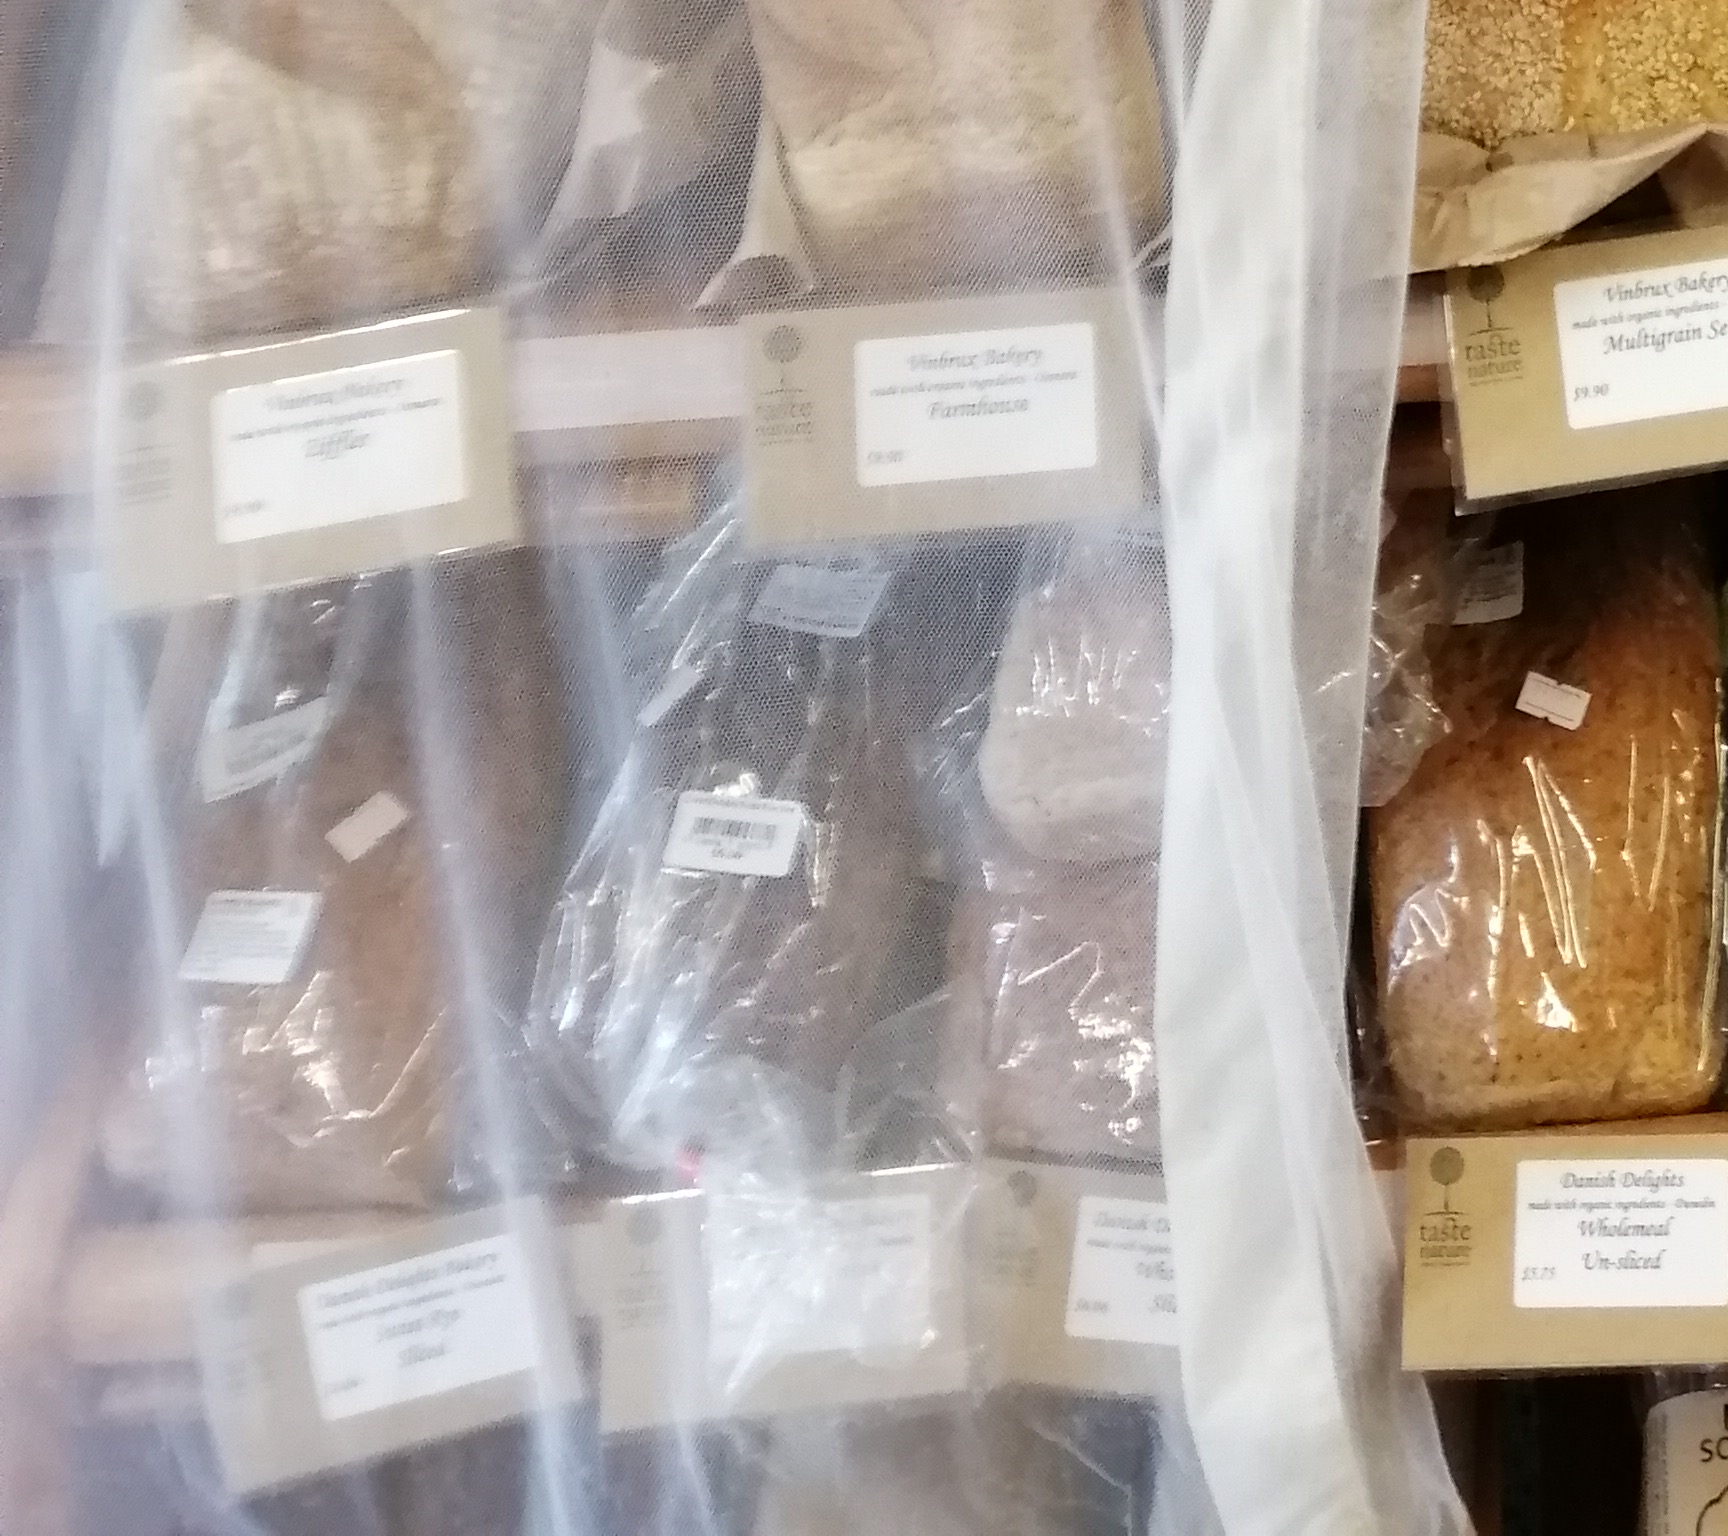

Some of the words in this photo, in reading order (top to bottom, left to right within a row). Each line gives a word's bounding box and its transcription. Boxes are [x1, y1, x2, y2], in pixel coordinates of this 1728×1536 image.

[1603, 280, 1673, 302] Vinbrux
[1600, 312, 1623, 325] with
[1626, 307, 1662, 323] organic
[1665, 301, 1718, 319] ingredients
[1603, 326, 1702, 354] Multigrain
[928, 395, 1028, 419] Farmhouse
[1560, 1170, 1616, 1189] Danish
[1620, 1170, 1685, 1193] Delights
[1578, 1216, 1675, 1237] Wholemeal
[1582, 1249, 1667, 1270] Un-sliced
